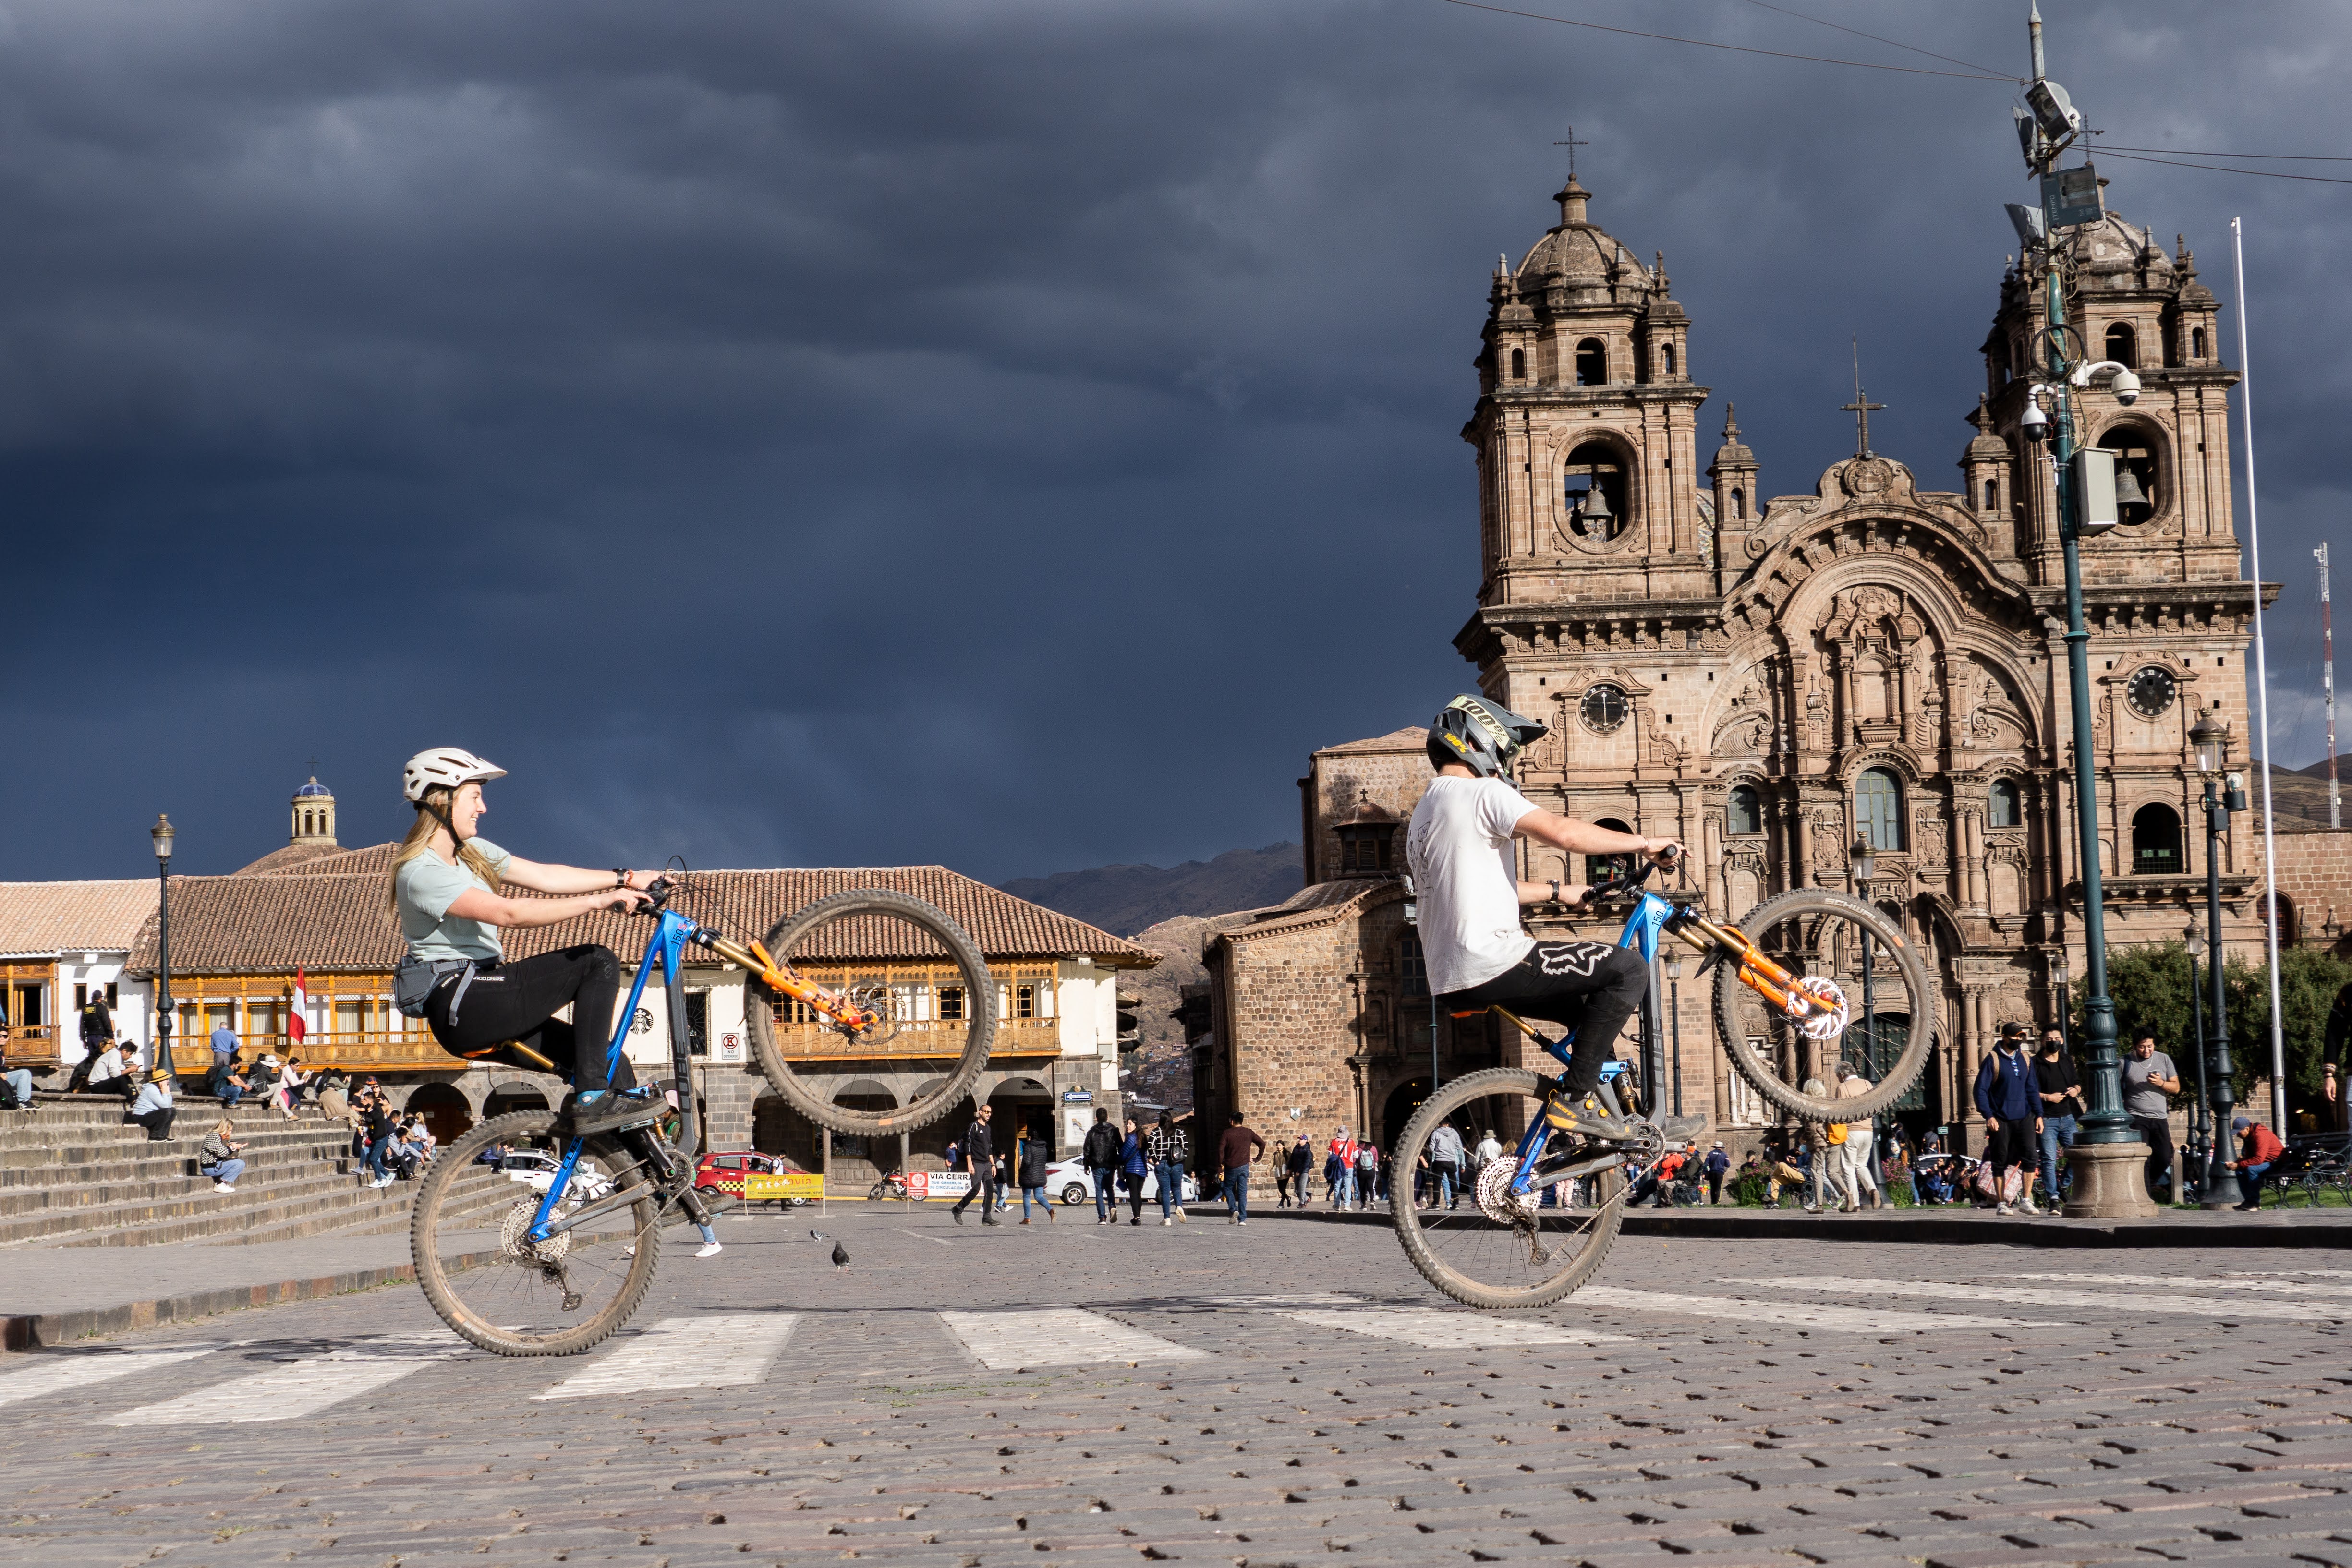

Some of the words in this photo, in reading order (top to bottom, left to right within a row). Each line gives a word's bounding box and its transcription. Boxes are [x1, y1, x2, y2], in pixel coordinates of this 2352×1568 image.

[1444, 732, 1468, 753] 100%
[671, 923, 687, 945] 150S
[1825, 898, 1896, 937] SCHWALBE
[1652, 1017, 1664, 1088] CUBE
[675, 1040, 691, 1113] CUBE
[1553, 1101, 1577, 1119] SCOTT
[562, 1137, 581, 1170] CUB
